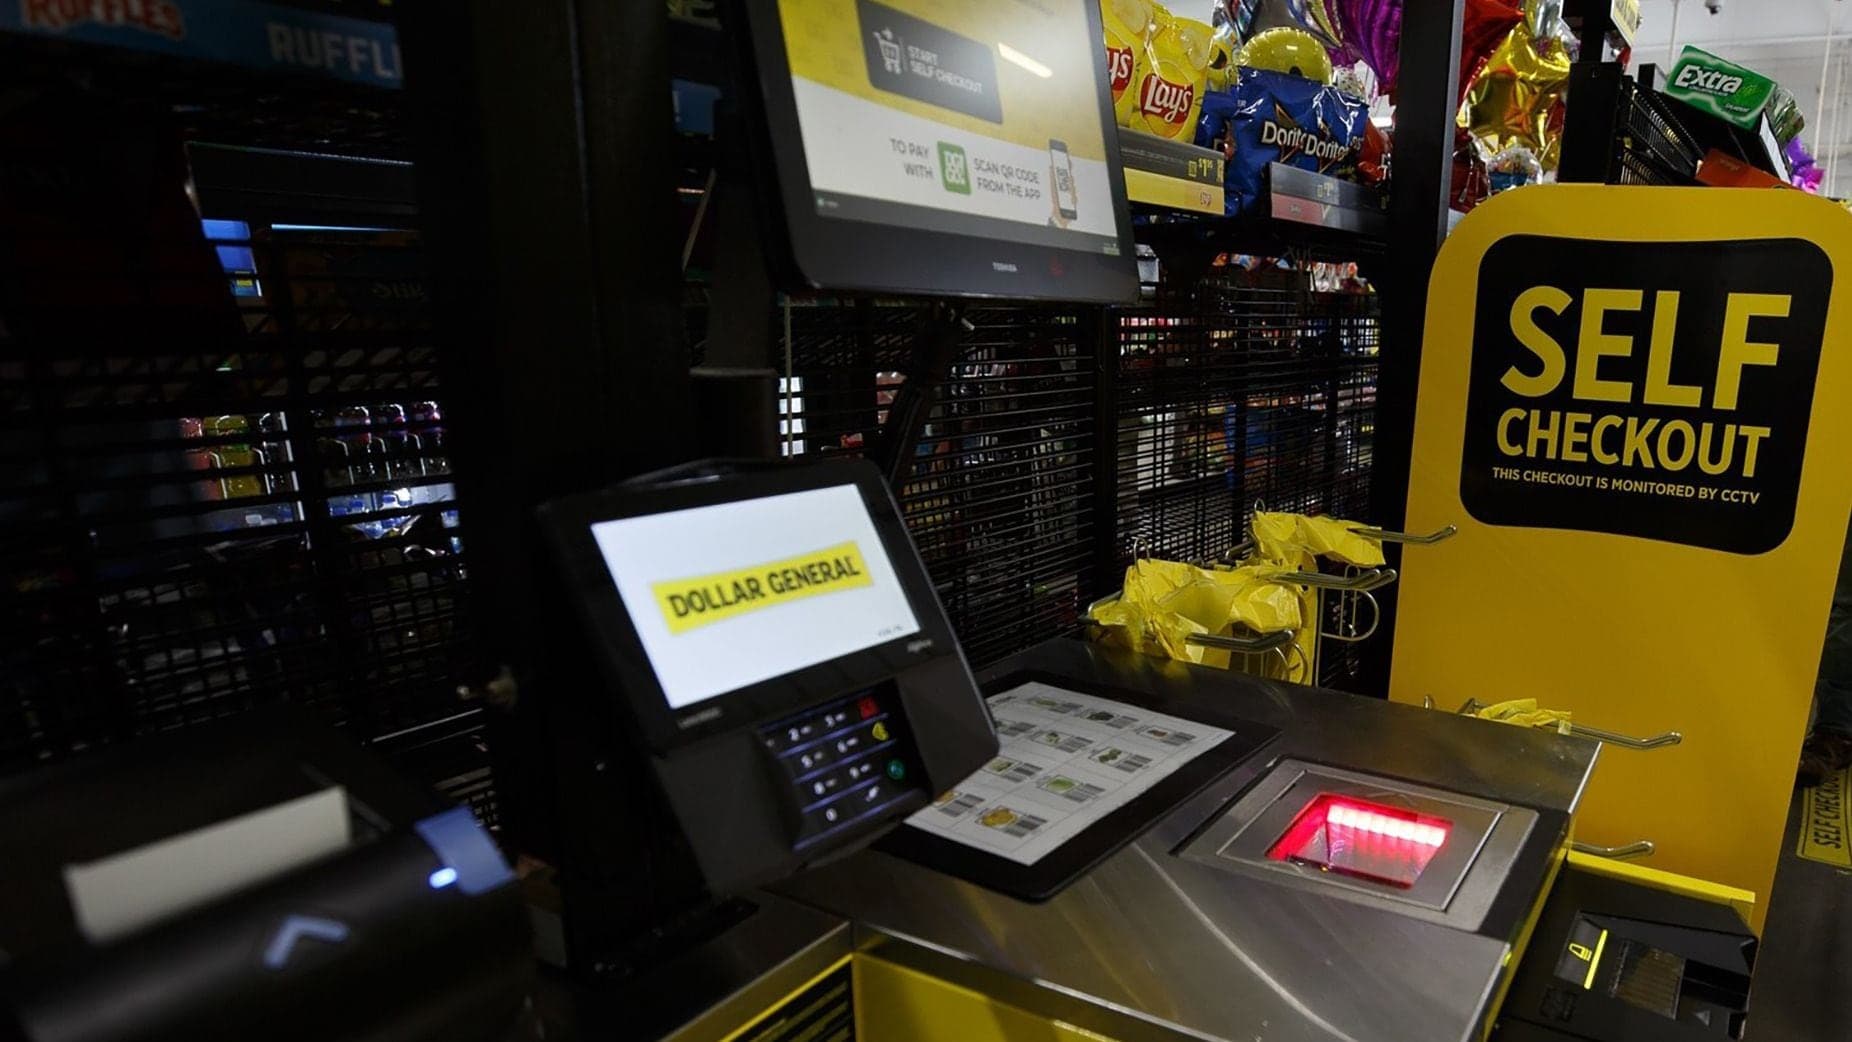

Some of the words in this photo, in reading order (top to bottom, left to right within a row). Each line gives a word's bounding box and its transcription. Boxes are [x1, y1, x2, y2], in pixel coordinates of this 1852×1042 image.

[908, 46, 938, 64] START
[910, 61, 934, 78] SELF
[935, 71, 982, 93] CHECKOUT
[1674, 64, 1743, 94] Extra
[1143, 75, 1192, 123] Lay's
[890, 138, 907, 155] TO
[908, 143, 930, 159] PAY
[904, 162, 934, 179] WITH
[974, 158, 1000, 176] SCAN
[1000, 163, 1014, 179] QR
[1014, 167, 1040, 184] CODE
[977, 177, 1005, 195] FROM
[1005, 183, 1024, 198] THE
[1024, 188, 1041, 201] APP
[1500, 286, 1793, 411] SELF
[1497, 408, 1770, 478] CHECKOUT
[1492, 466, 1521, 482] THIS
[1523, 468, 1593, 488] CHECKOUT
[1595, 476, 1608, 490] IS
[1611, 478, 1695, 499] MONITORED
[1698, 486, 1718, 501] BY
[1720, 488, 1760, 505] CCTV
[667, 576, 763, 620] DOLLAR
[767, 553, 862, 596] GENERAL
[1813, 816, 1842, 850] SELF
